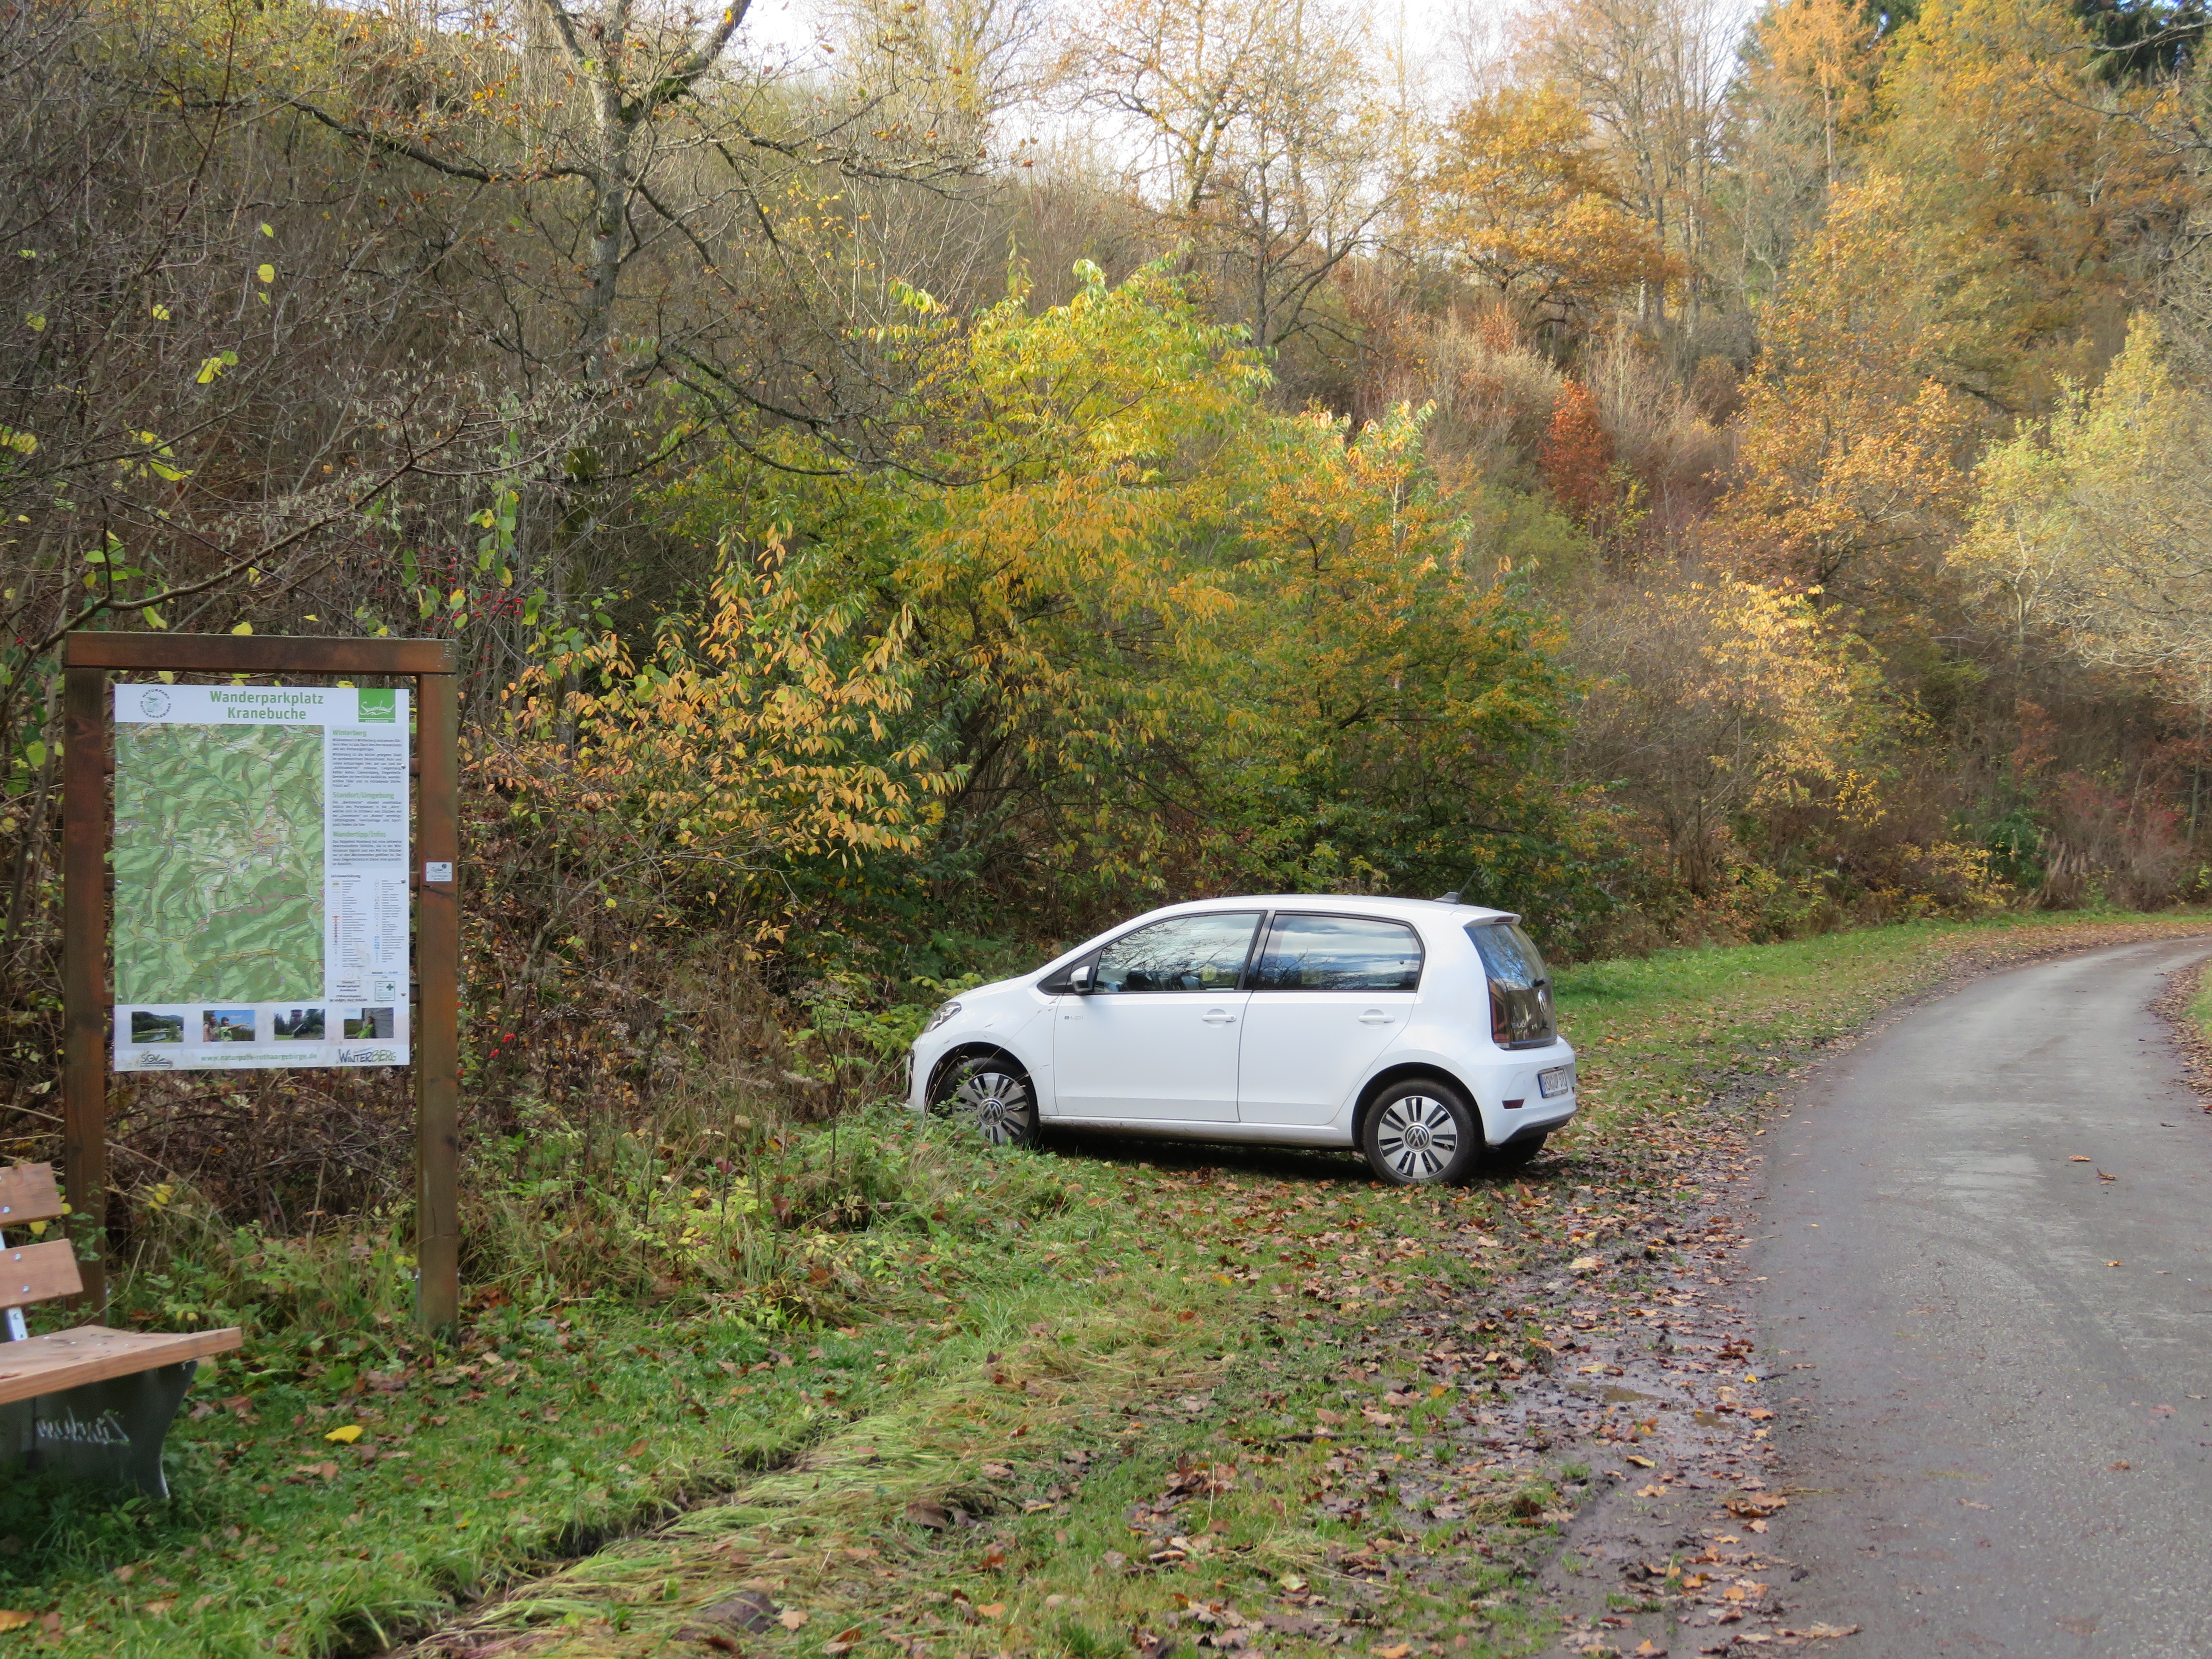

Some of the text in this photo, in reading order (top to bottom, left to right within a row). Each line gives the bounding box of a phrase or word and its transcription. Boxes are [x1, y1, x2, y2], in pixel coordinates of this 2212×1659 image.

[143, 689, 170, 699] NATURPARK
[210, 690, 323, 706] Wanderparkplatz
[140, 701, 172, 719] ROTHAARGEBIRGE
[228, 707, 306, 719] Kranebuche
[359, 701, 394, 714] Sauerland
[201, 1052, 317, 1061] www.naturpark-rothaargebirge.de
